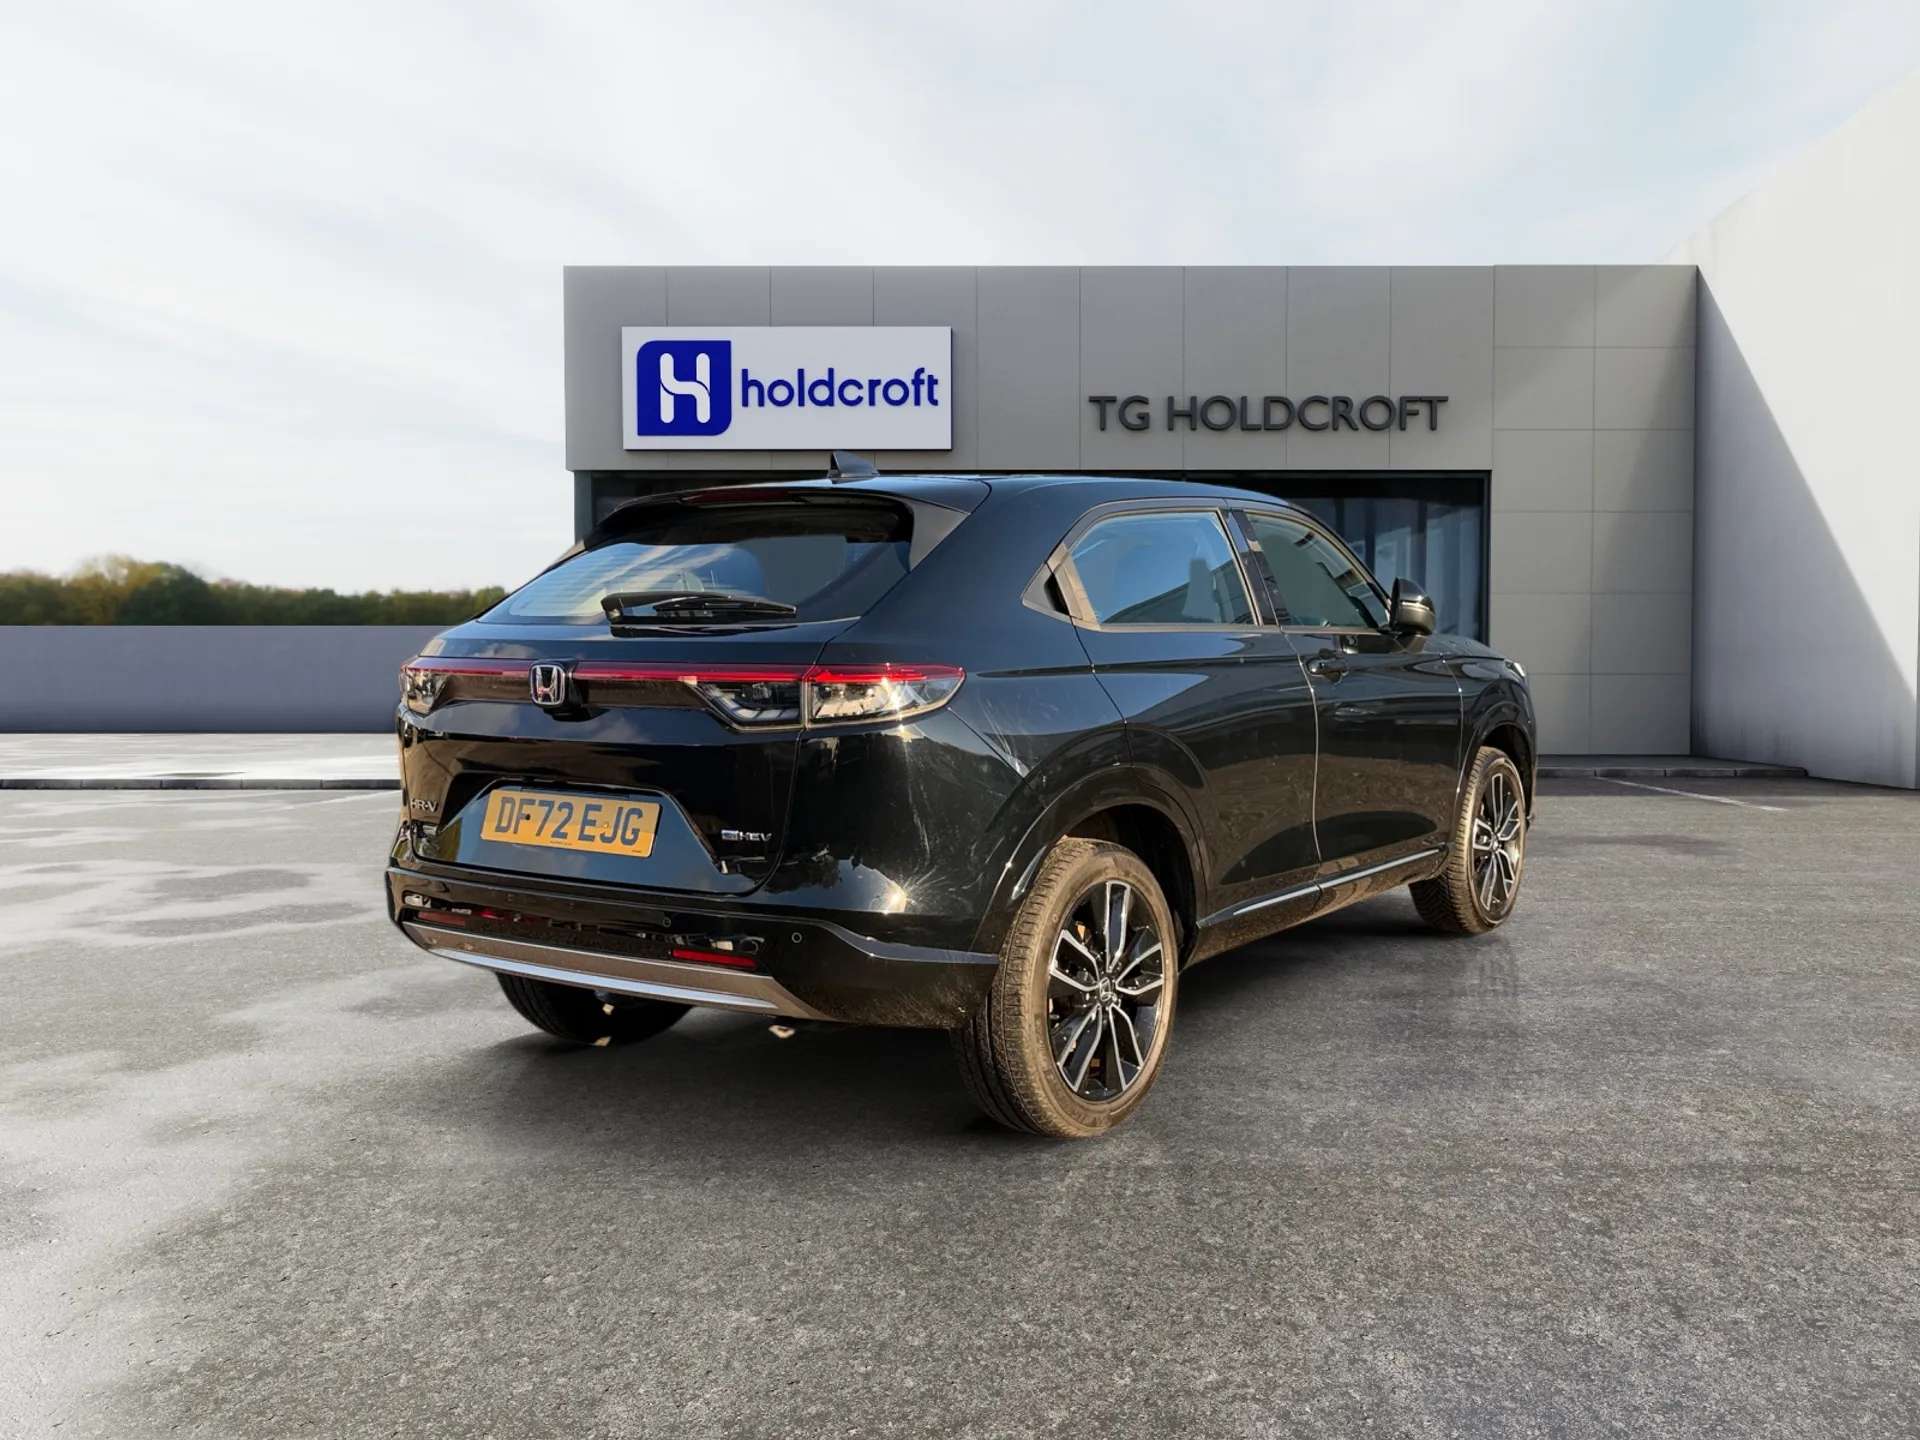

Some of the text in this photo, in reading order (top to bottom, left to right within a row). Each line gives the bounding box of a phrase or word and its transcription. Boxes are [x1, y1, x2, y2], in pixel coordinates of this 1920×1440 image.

[741, 367, 939, 407] holdcroft
[1089, 395, 1449, 431] TG HOLDCROFT
[494, 796, 643, 847] DF72 EJG
